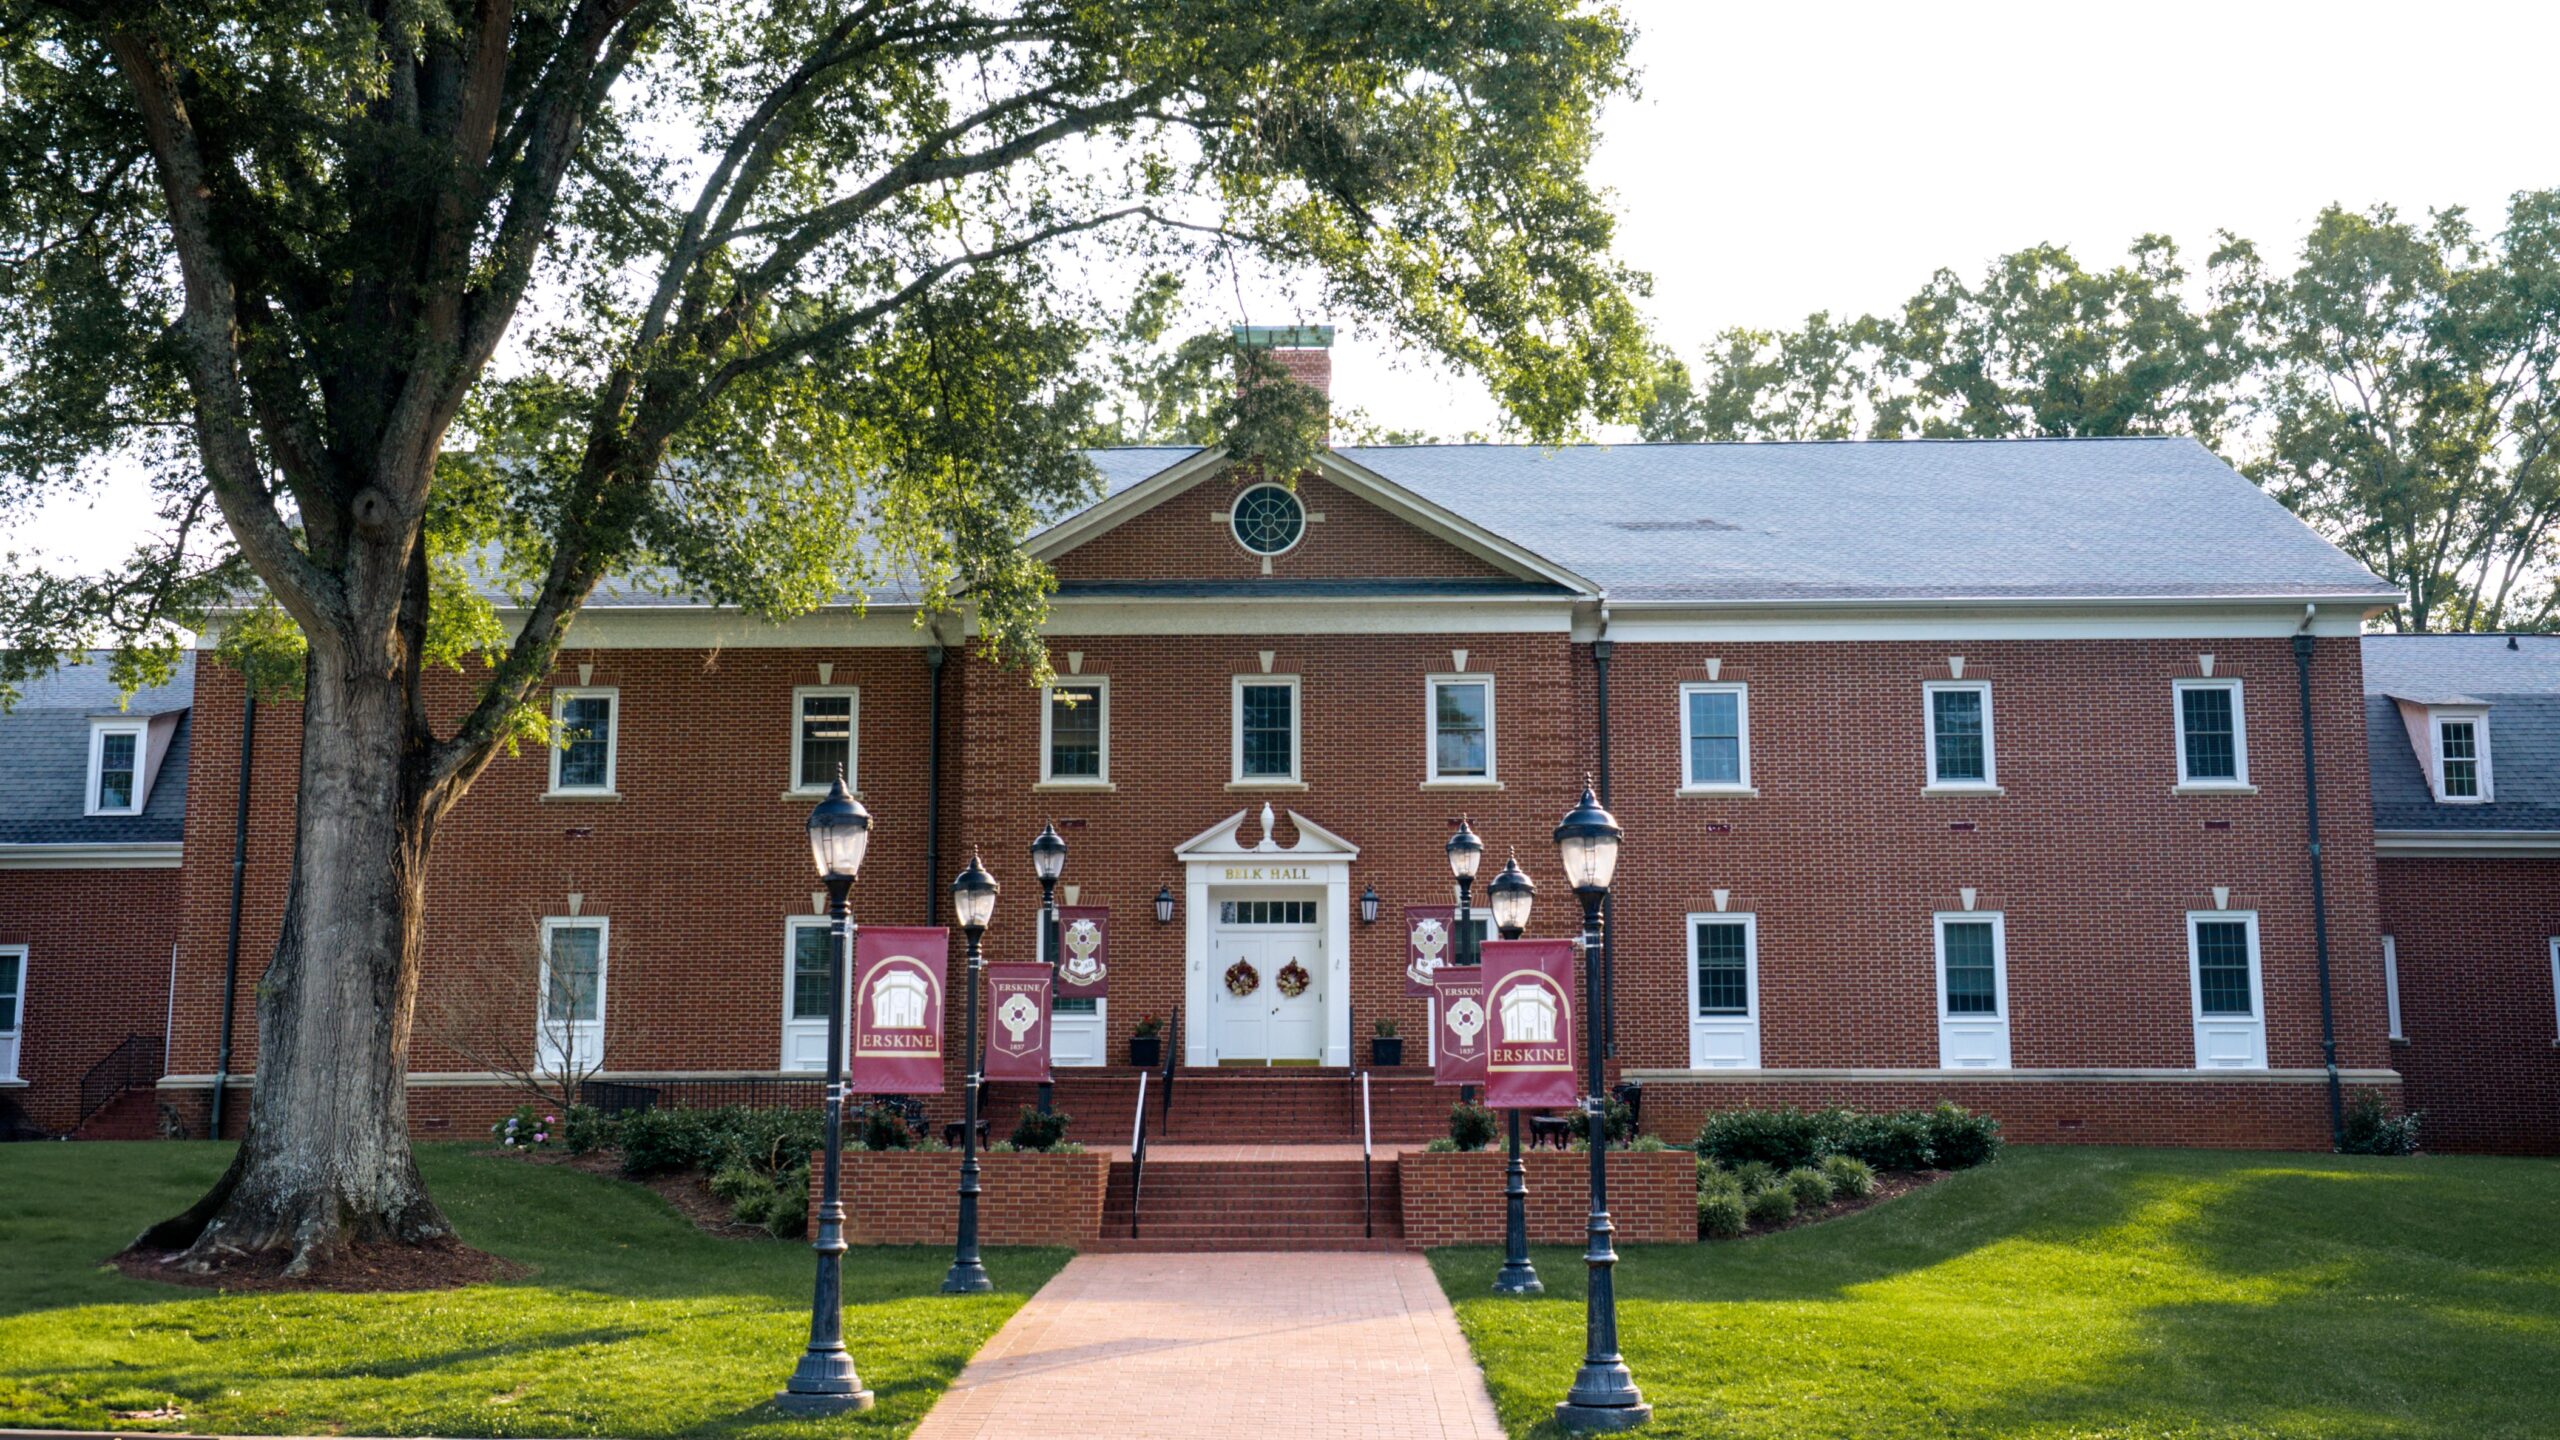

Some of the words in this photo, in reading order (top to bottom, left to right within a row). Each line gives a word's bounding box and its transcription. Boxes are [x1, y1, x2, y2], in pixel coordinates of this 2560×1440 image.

[1225, 868, 1263, 880] BELK
[1270, 868, 1310, 880] HALL
[998, 983, 1041, 992] ERSKINE
[862, 1034, 935, 1048] ERSKINE
[1493, 1048, 1567, 1062] ERSKINE
